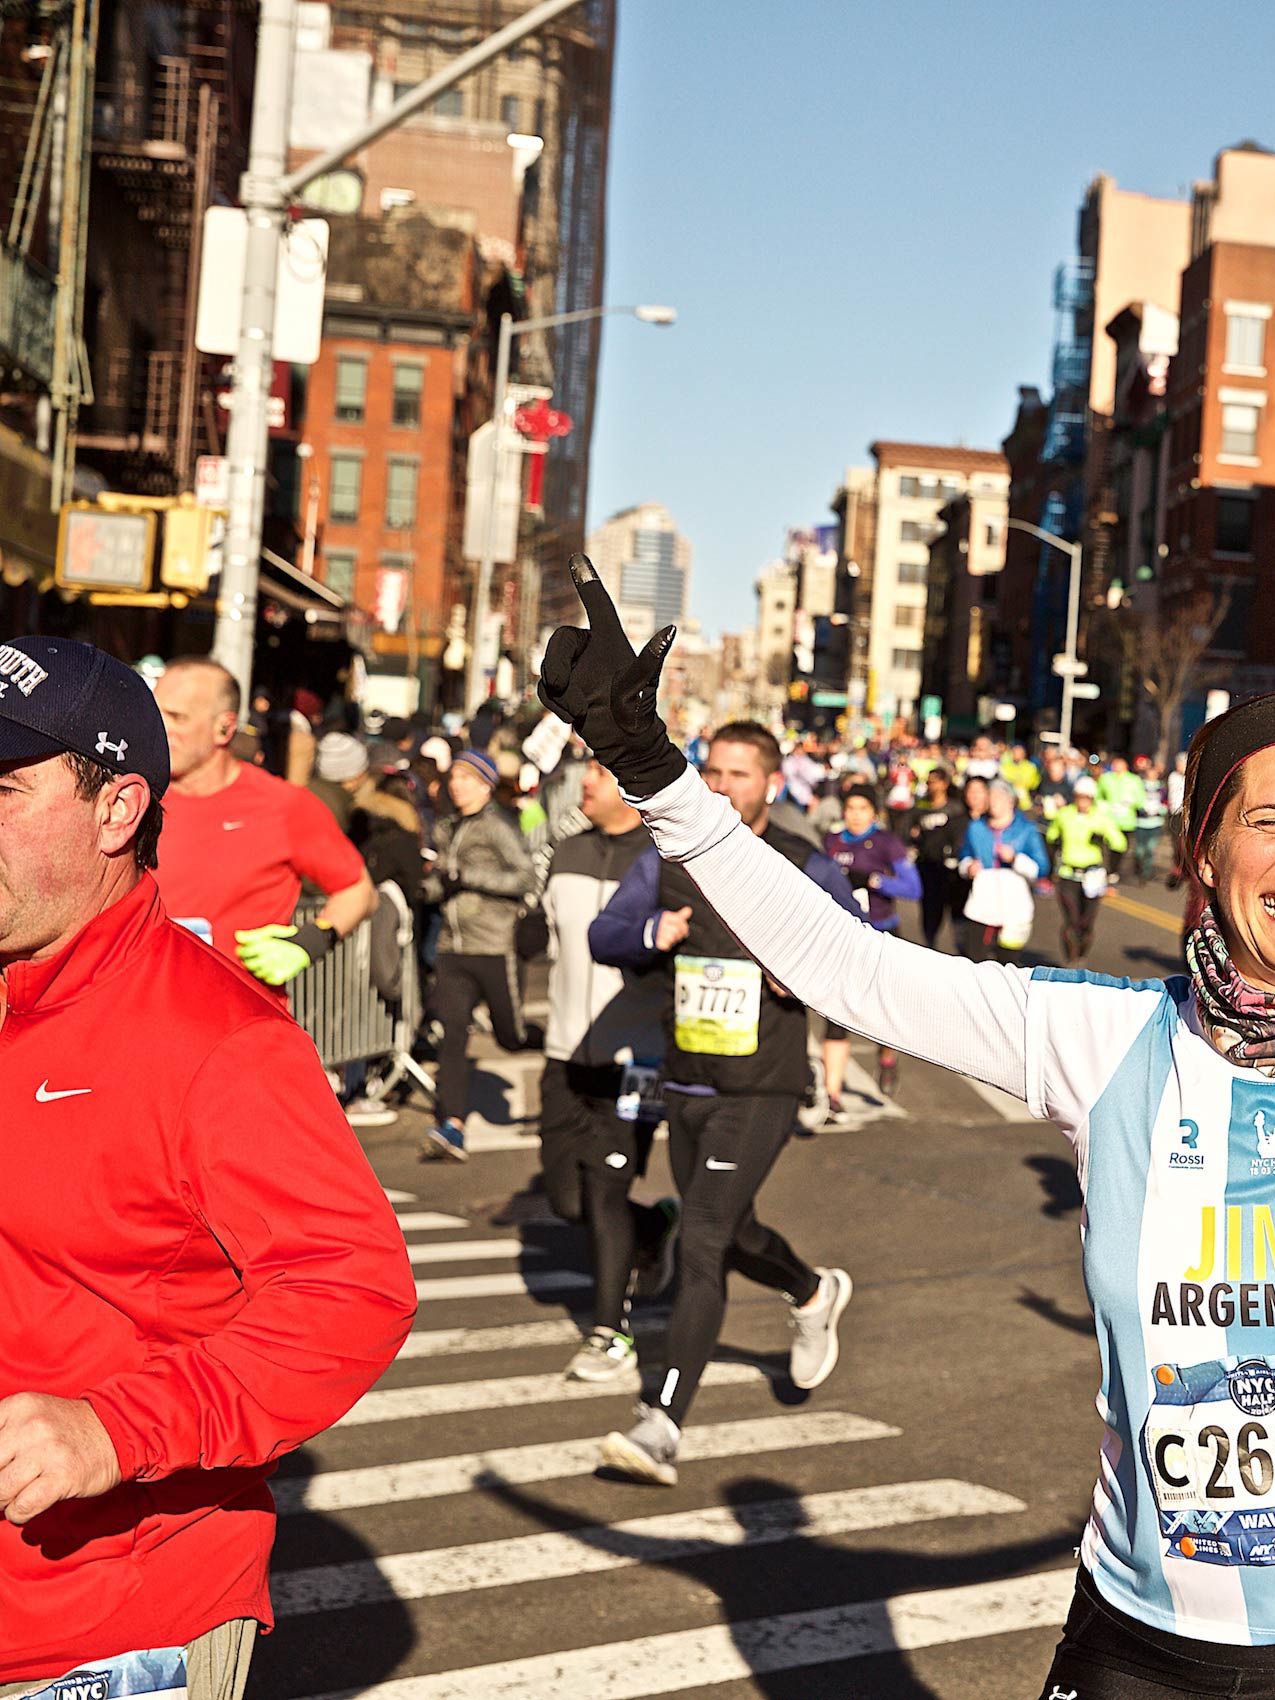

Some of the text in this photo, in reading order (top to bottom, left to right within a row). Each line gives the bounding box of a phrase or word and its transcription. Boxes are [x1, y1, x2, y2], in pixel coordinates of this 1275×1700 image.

[1251, 1159, 1270, 1168] NYC
[1250, 1167, 1260, 1176] 18
[1261, 1167, 1271, 1175] 03
[1237, 1378, 1275, 1394] NYC
[1241, 1393, 1275, 1407] HALF
[1191, 1538, 1218, 1546] NITED
[62, 1682, 103, 1700] NYC
